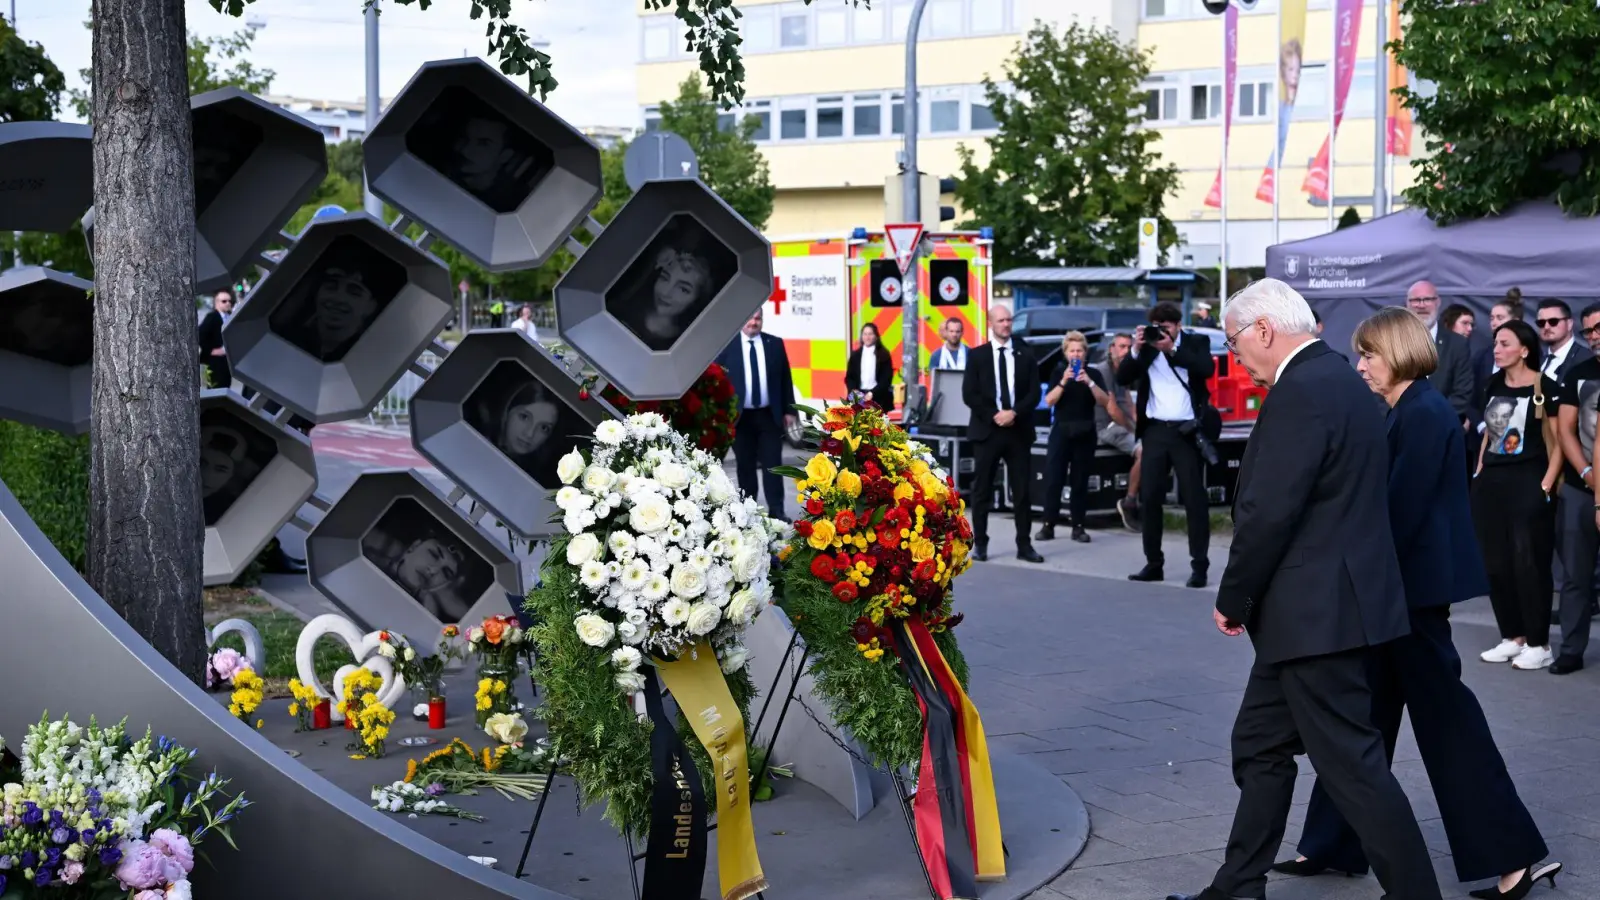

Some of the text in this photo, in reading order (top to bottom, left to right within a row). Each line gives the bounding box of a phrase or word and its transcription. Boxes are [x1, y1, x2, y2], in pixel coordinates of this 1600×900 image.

[1308, 253, 1382, 266] Landeshauptstadt
[1308, 267, 1348, 277] München
[791, 275, 837, 288] Bayerisches
[1308, 277, 1366, 288] Kulturreferat
[791, 289, 812, 301] Rotes
[791, 304, 813, 316] Kreuz
[699, 705, 739, 809] München
